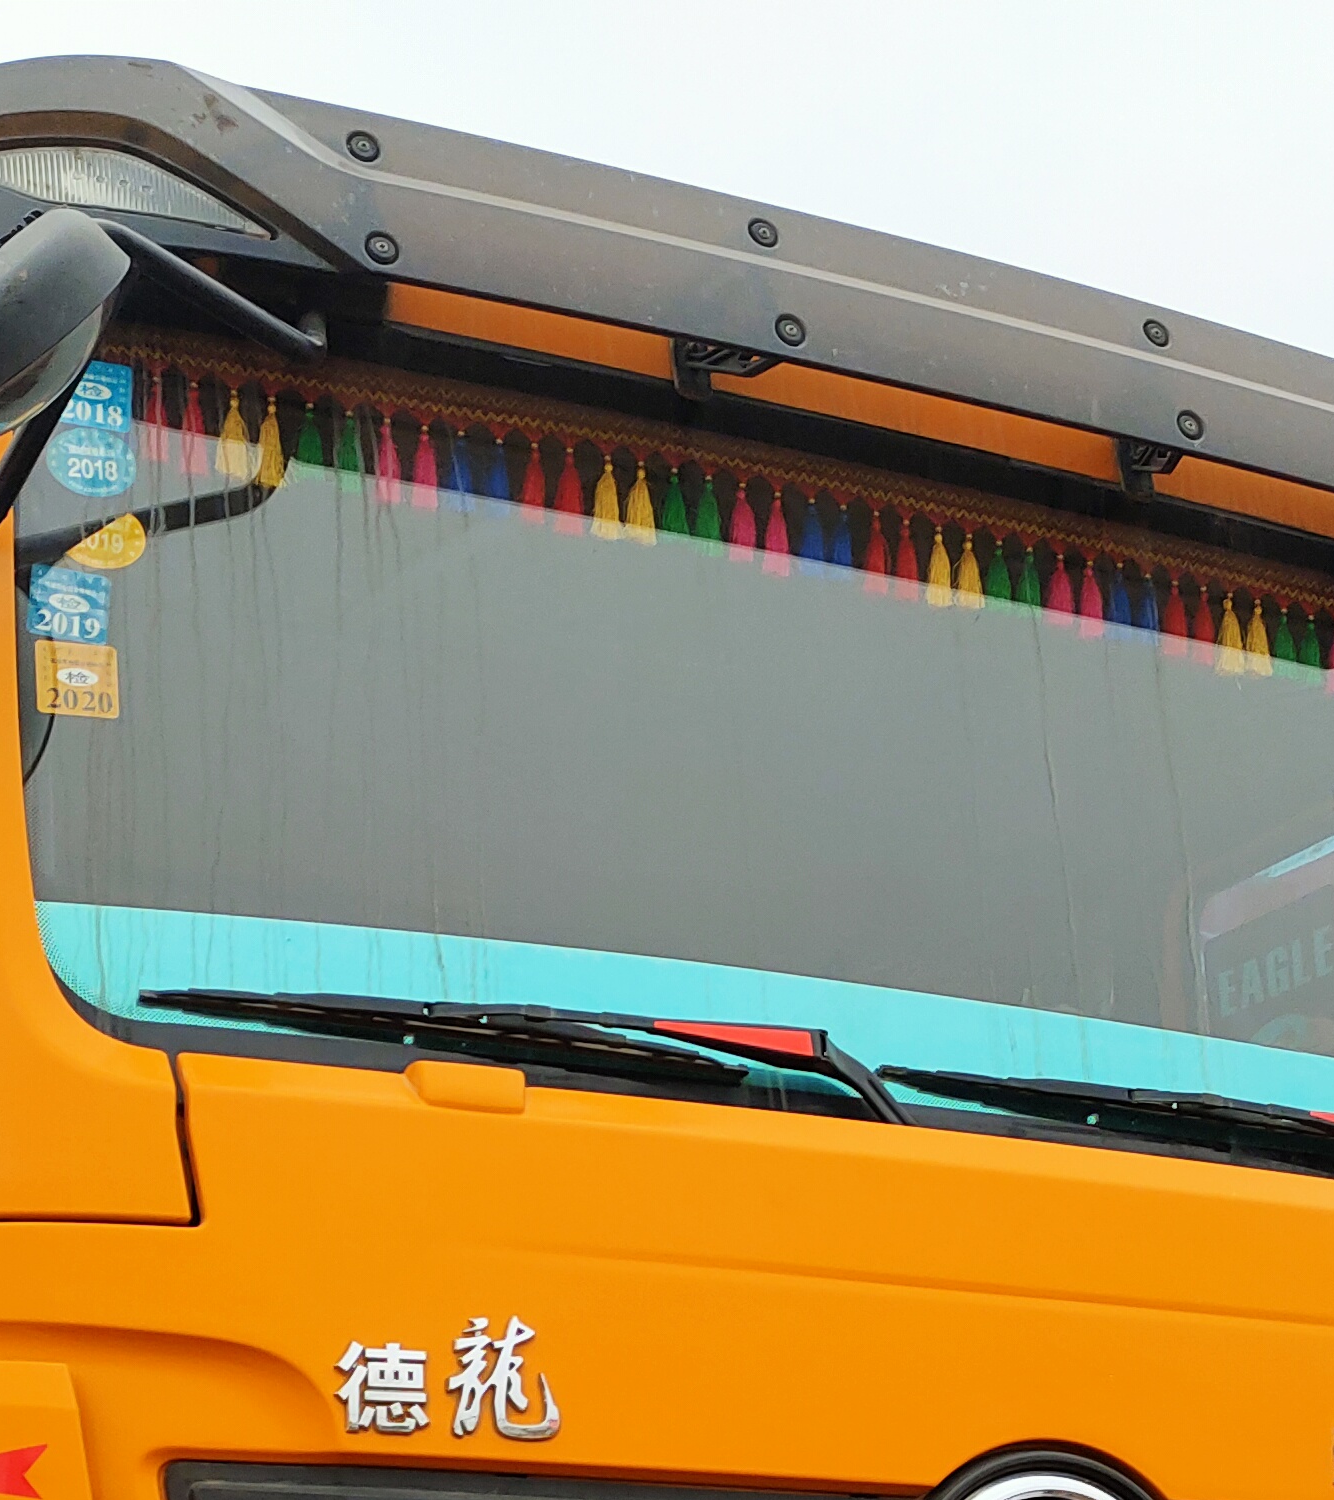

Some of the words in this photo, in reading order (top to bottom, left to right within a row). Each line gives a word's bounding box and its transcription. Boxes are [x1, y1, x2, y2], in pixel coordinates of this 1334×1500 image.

[64, 400, 124, 427] 2018
[67, 457, 119, 482] 2018
[79, 532, 125, 554] 019
[34, 608, 102, 640] 2019
[46, 687, 114, 714] 2020
